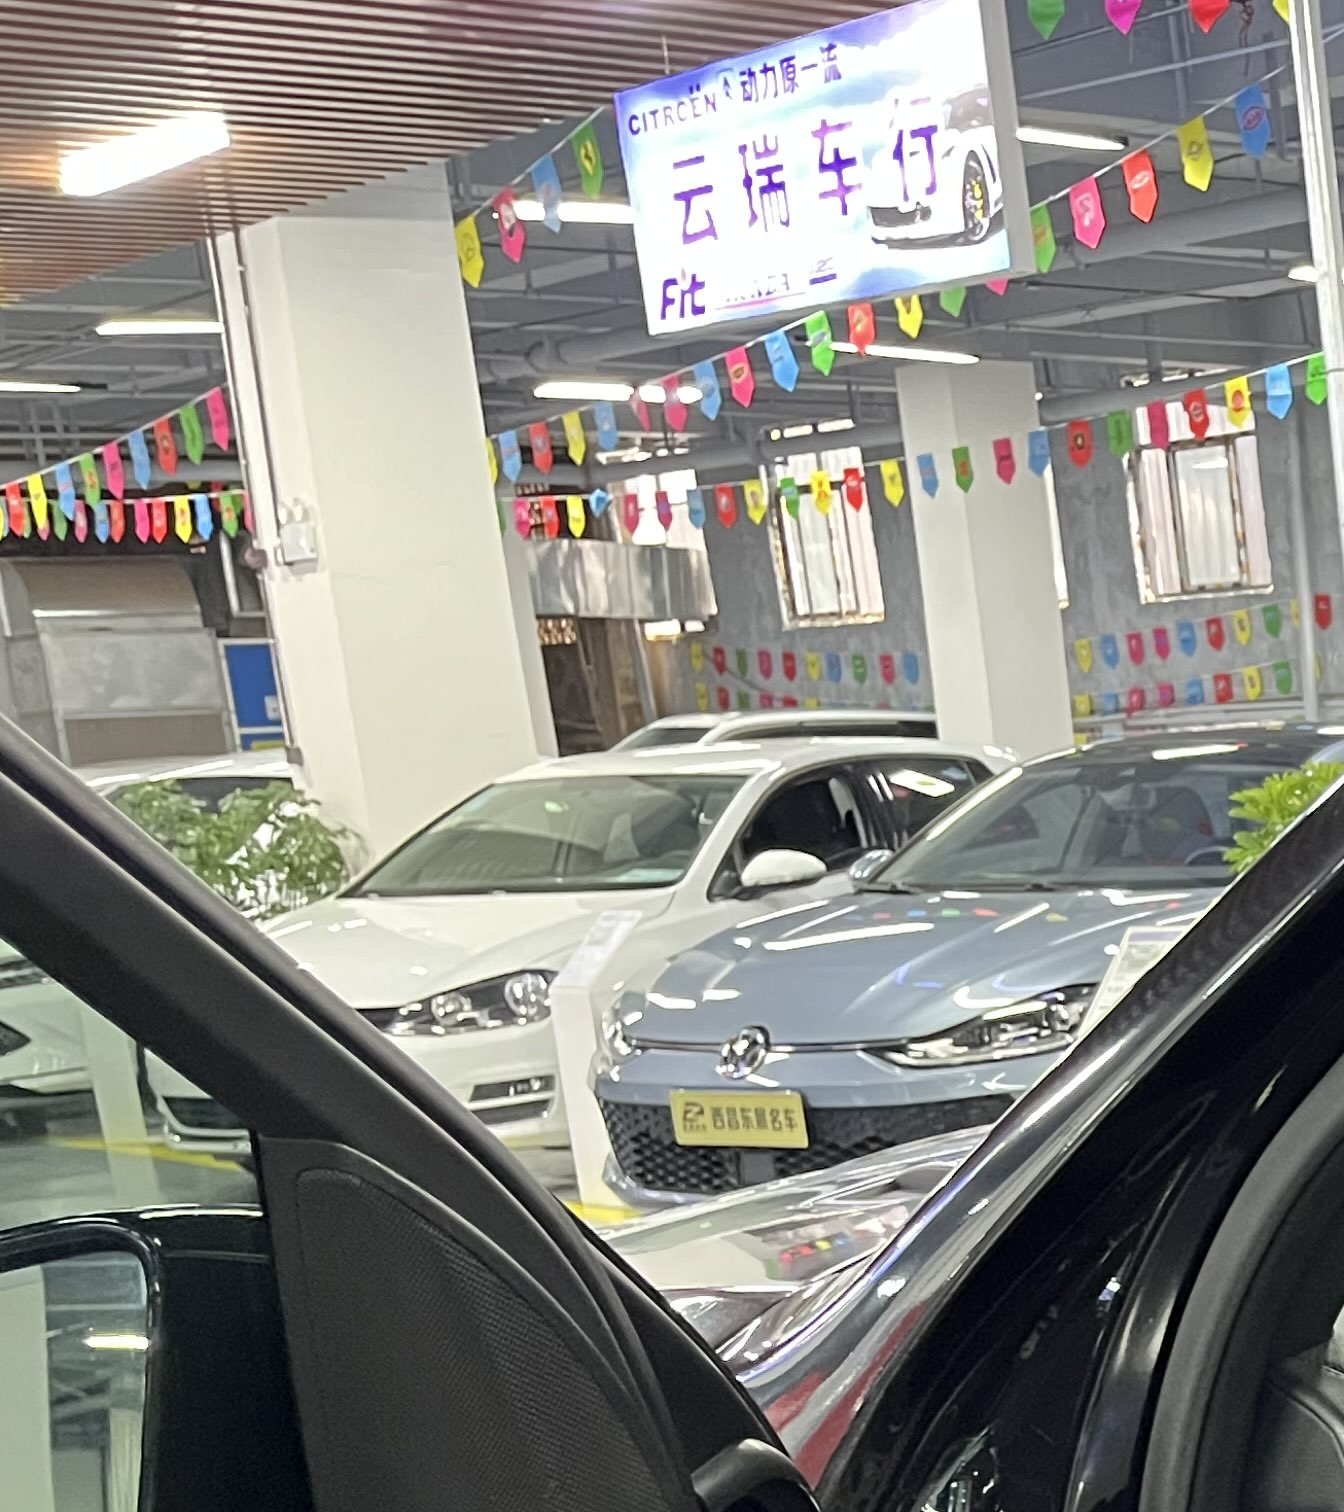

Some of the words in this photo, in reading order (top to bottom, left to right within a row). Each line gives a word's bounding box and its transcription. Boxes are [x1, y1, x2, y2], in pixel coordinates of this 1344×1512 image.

[672, 97, 939, 246] 云瑞车行
[660, 268, 706, 321] Fit
